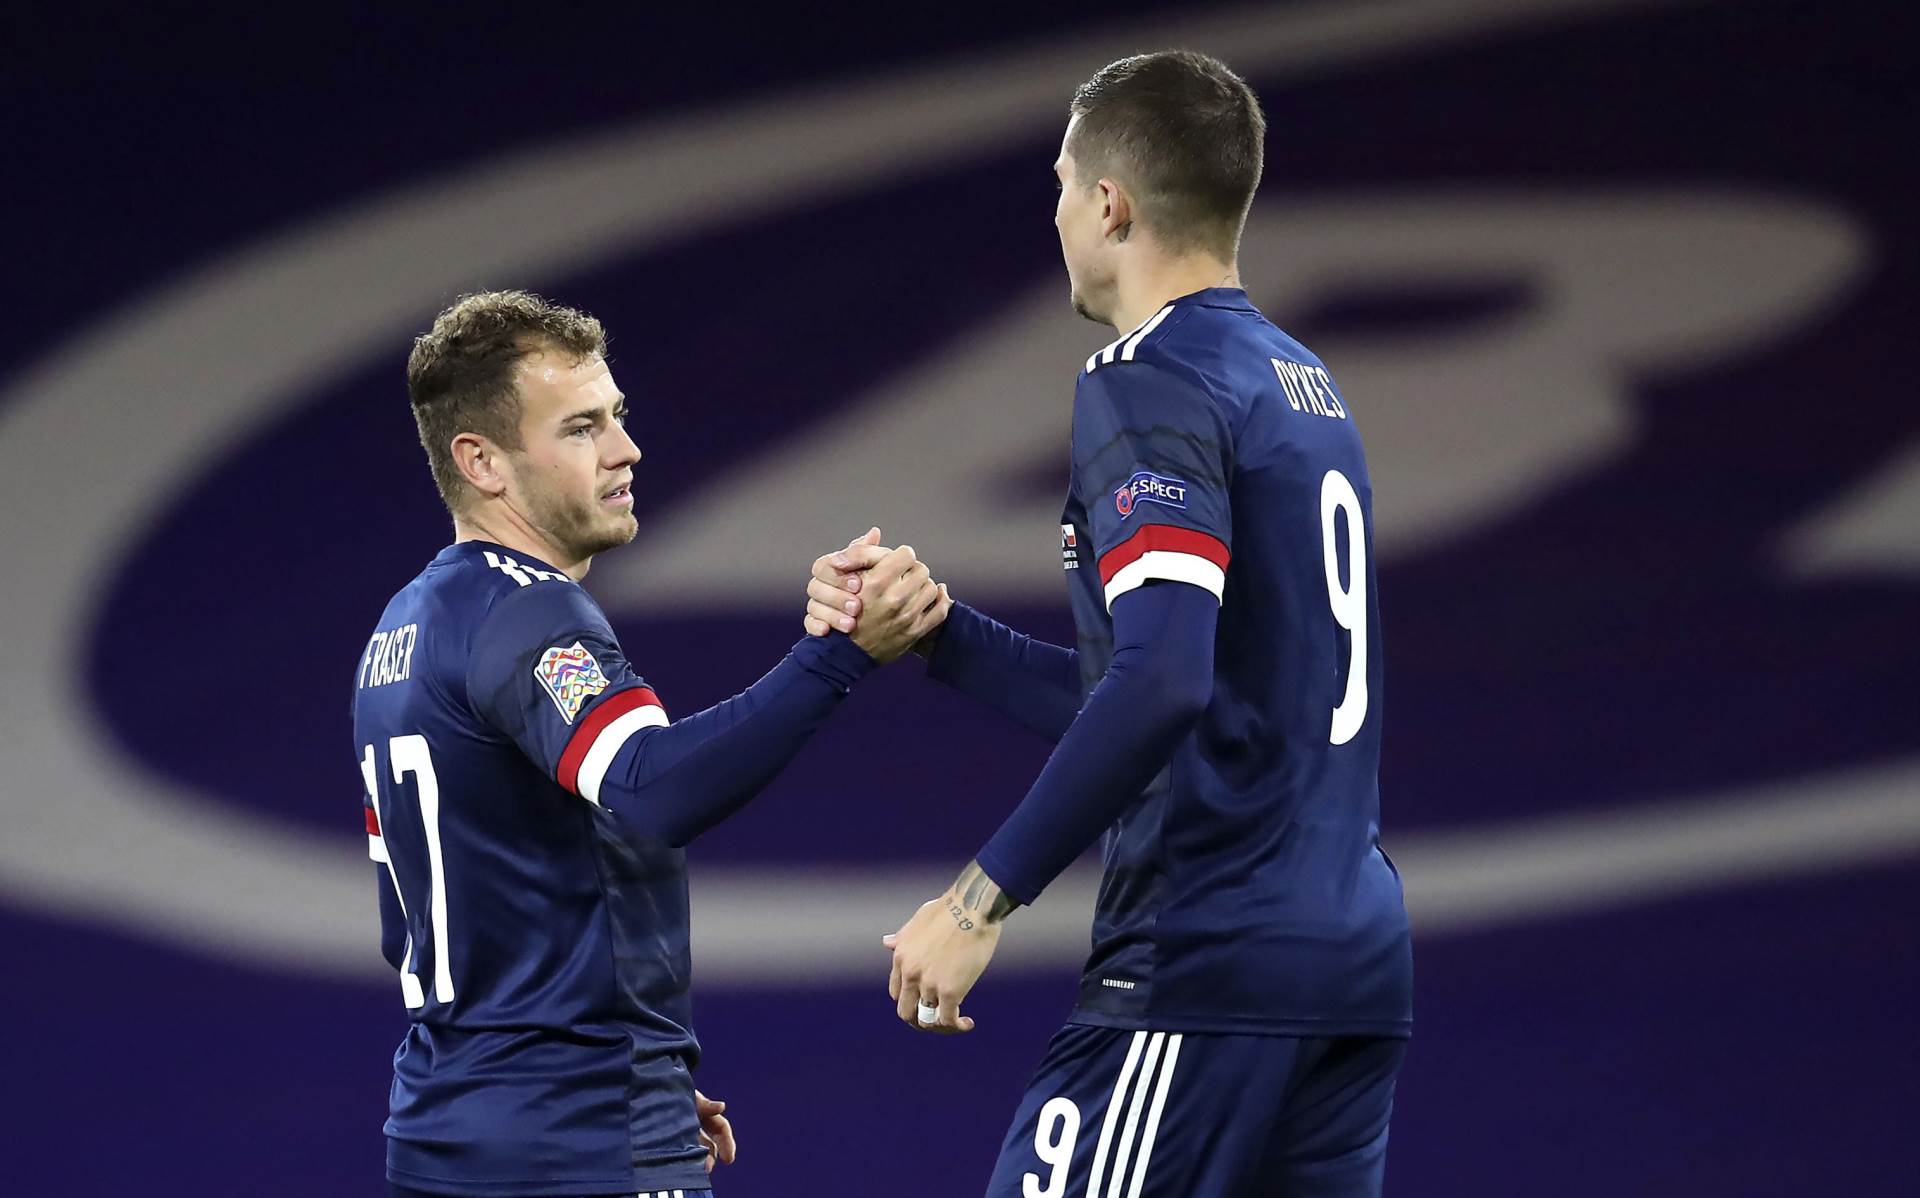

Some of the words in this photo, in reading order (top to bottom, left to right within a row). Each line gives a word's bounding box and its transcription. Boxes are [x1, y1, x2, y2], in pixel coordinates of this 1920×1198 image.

[1270, 357, 1346, 419] DYKES
[359, 623, 417, 689] FRASER
[1320, 469, 1368, 745] 9
[360, 734, 455, 1009] 17
[1022, 1096, 1081, 1198] 9
